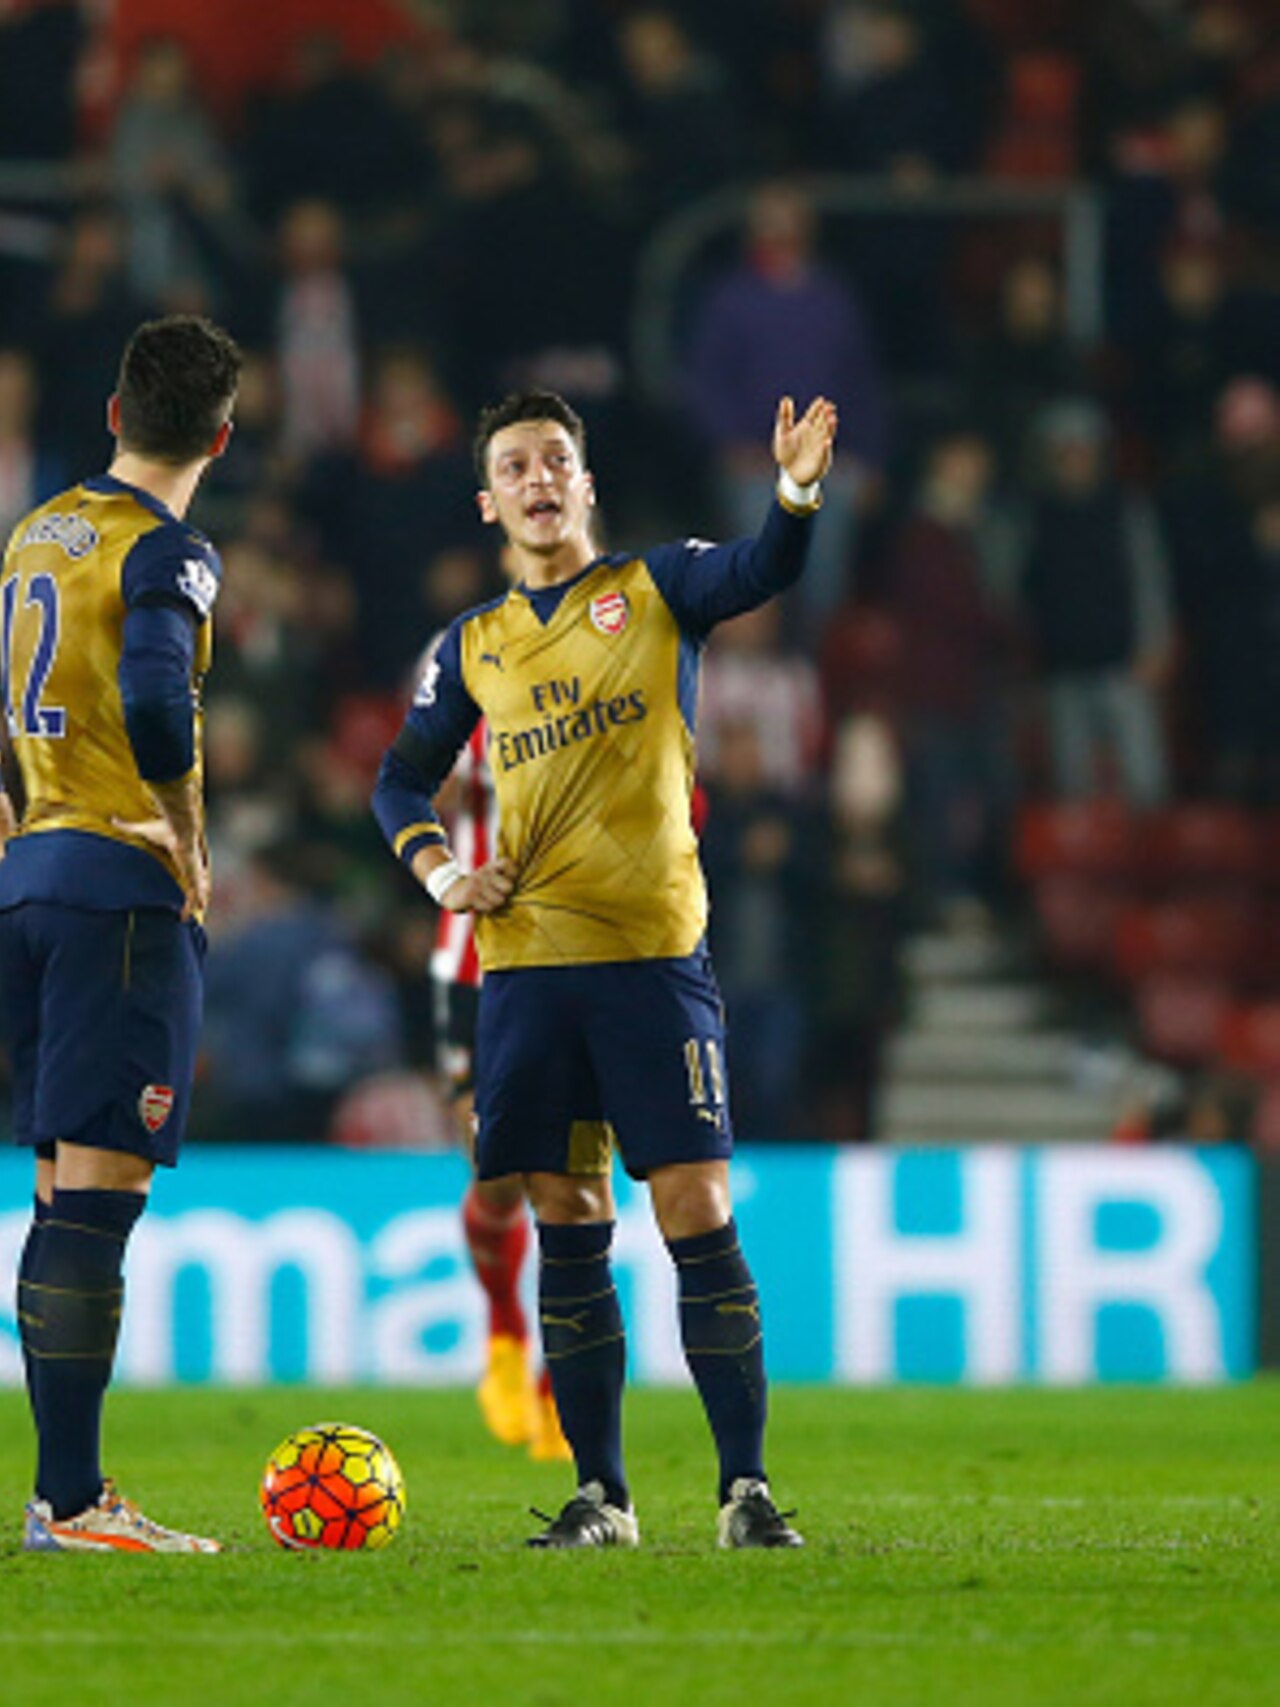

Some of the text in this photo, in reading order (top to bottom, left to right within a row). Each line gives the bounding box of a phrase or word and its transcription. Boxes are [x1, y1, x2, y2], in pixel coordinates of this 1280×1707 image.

[0, 571, 67, 740] 12
[531, 676, 580, 712] Fly
[498, 688, 647, 772] Emirates
[830, 1143, 1228, 1386] HR
